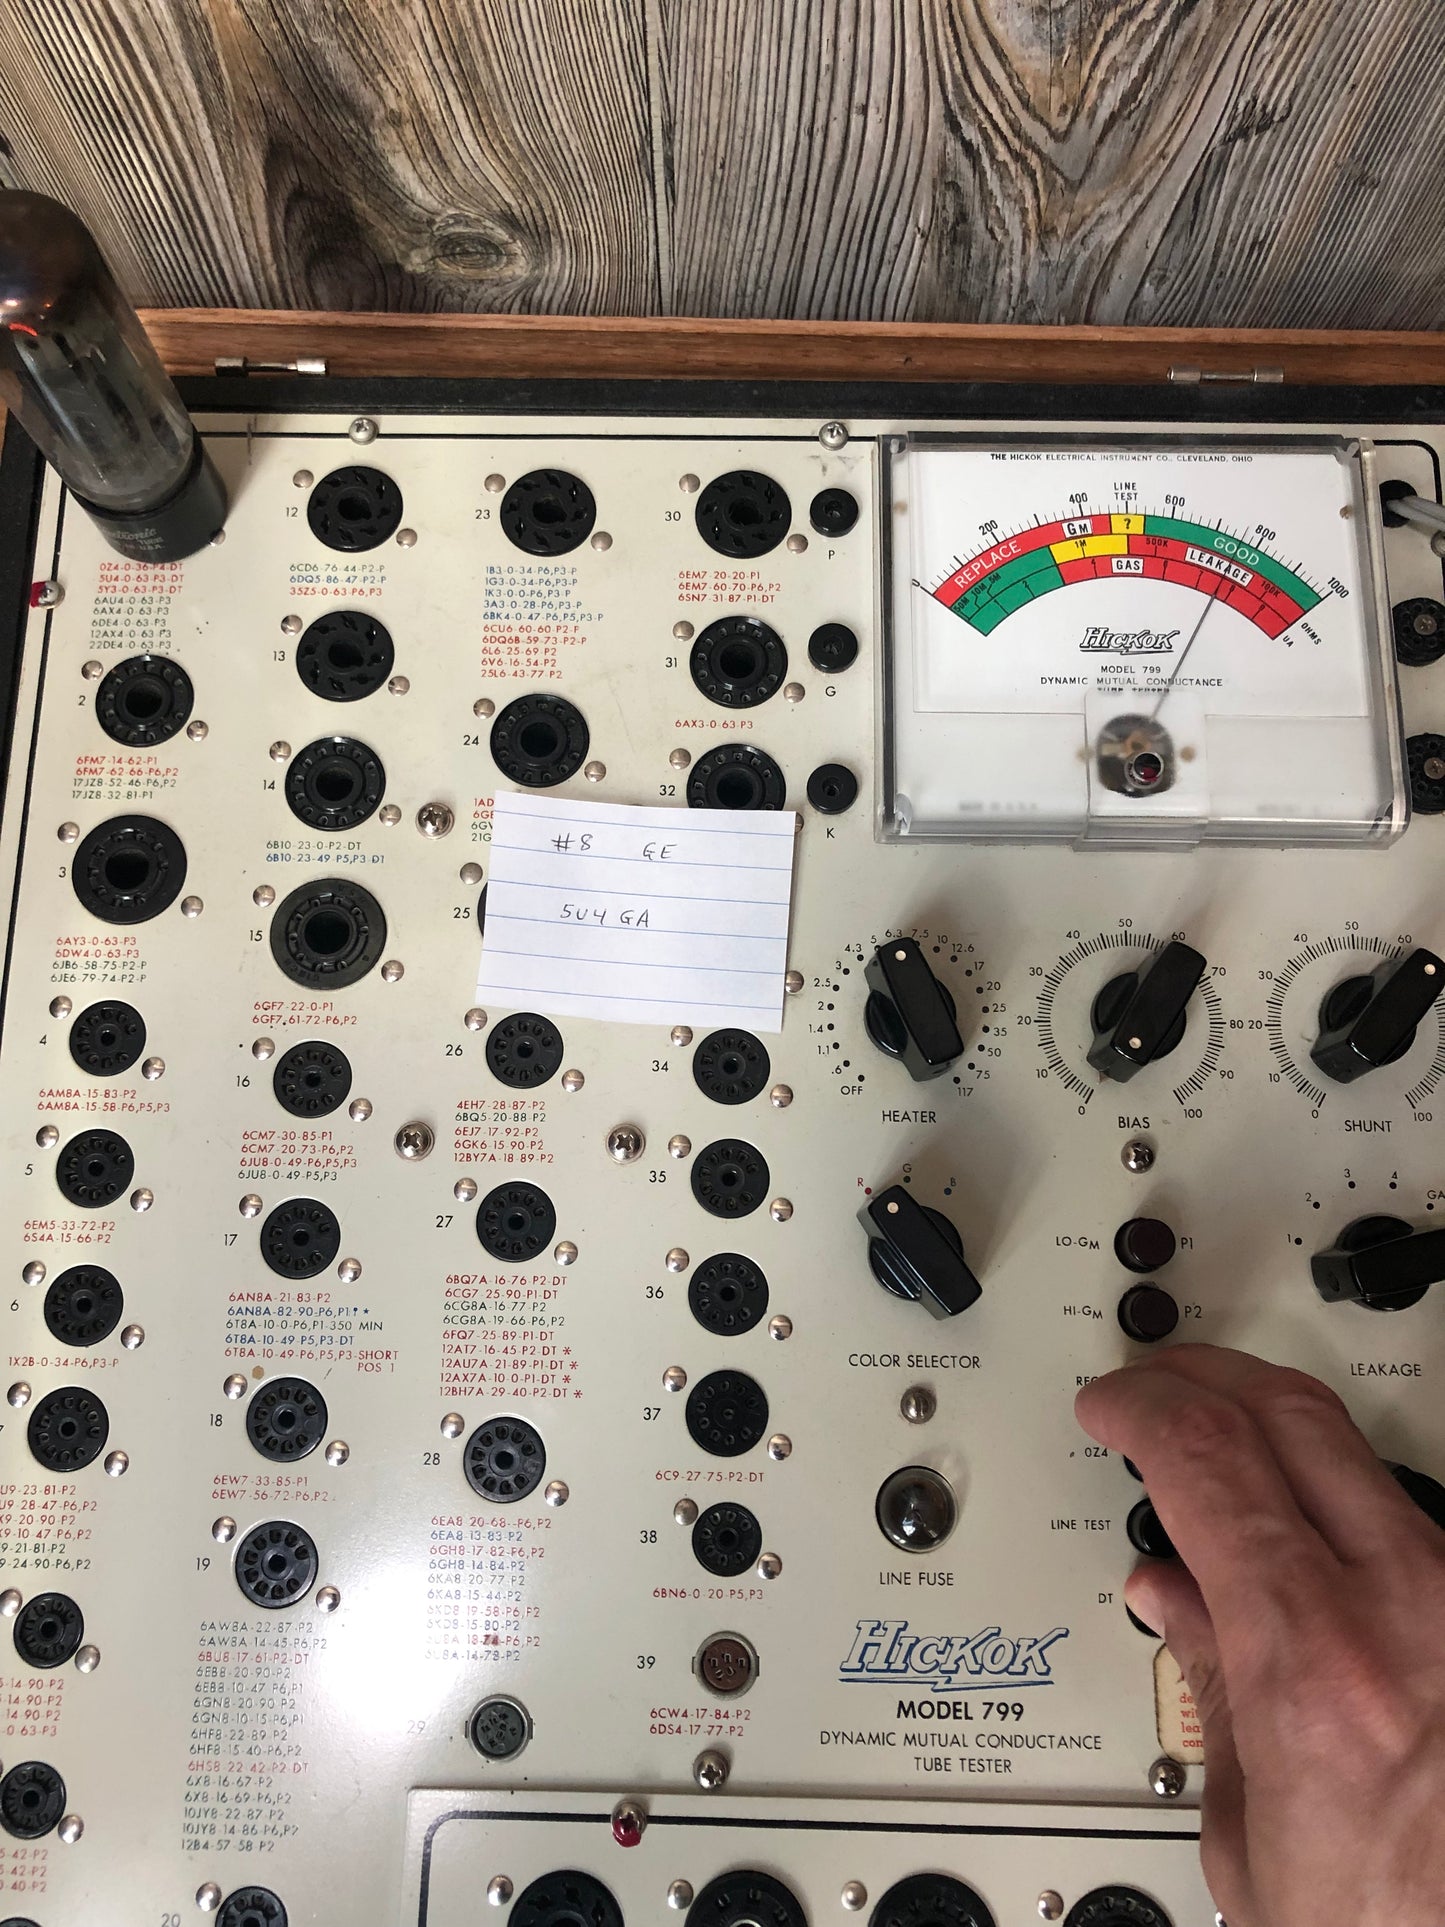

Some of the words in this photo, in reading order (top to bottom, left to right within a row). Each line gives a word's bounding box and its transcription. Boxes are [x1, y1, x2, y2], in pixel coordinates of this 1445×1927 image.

[1069, 493, 1088, 503] 400
[1115, 492, 1138, 500] TEST
[1165, 495, 1185, 506] 600
[285, 508, 298, 517] 12
[475, 510, 490, 519] 23
[665, 512, 681, 522] 30
[979, 520, 998, 535] 200
[1255, 525, 1276, 541] 800
[1214, 537, 1260, 566] GOOD
[954, 541, 1021, 588] REPLACE
[1116, 560, 1141, 570] GAS
[1189, 549, 1250, 583] LEAKAGE
[1327, 577, 1349, 599] 1000
[1301, 622, 1322, 645] OHMS
[273, 651, 285, 662] 13
[665, 658, 678, 668] 31
[1097, 677, 1138, 685] MUTUAL
[1146, 678, 1223, 686] CONDUCTANCE
[78, 696, 85, 706] 2
[463, 736, 479, 746] 24
[263, 780, 275, 791] 14
[659, 786, 675, 796] 32
[552, 834, 592, 851] #8
[642, 842, 677, 860] GE
[58, 867, 66, 878] 3
[453, 908, 470, 918] 25
[560, 904, 606, 925] 5U4
[620, 910, 649, 927] GA
[1118, 918, 1132, 928] 50
[1345, 921, 1359, 931] 50
[249, 930, 262, 942] 15
[937, 935, 948, 944] 10
[1066, 930, 1081, 939] 40
[1171, 931, 1186, 941] 60
[844, 944, 862, 952] 4.3
[952, 943, 974, 952] 12.6
[974, 962, 984, 971] 17
[1029, 966, 1043, 976] 30
[1212, 966, 1226, 976] 70
[814, 978, 831, 987] 2.5
[987, 982, 1001, 991] 20
[992, 1003, 1006, 1012] 25
[1017, 1016, 1031, 1026] 20
[1230, 1020, 1245, 1030] 80
[1248, 1020, 1263, 1030] 20
[994, 1027, 1007, 1036] 35
[39, 1034, 47, 1045] 4
[445, 1045, 463, 1056] 26
[987, 1048, 1001, 1057] 50
[651, 1060, 669, 1071] 34
[1219, 1069, 1234, 1079] 90
[236, 1076, 250, 1088] 16
[841, 1086, 863, 1096] OFF
[957, 1087, 973, 1097] 117
[882, 1111, 936, 1124] HEATER
[1184, 1109, 1203, 1119] 100
[1413, 1112, 1432, 1122] 100
[1118, 1116, 1150, 1129] BIAS
[1344, 1120, 1393, 1133] SHUNT
[24, 1163, 33, 1176] 5
[903, 1163, 911, 1173] G
[648, 1171, 666, 1182] 35
[857, 1178, 864, 1187] R
[950, 1178, 956, 1187] B
[435, 1216, 453, 1227] 27
[224, 1234, 238, 1246] 17
[1181, 1237, 1193, 1250] P1
[646, 1287, 664, 1298] 36
[10, 1299, 19, 1311] 6
[1185, 1305, 1202, 1319] P2
[359, 1321, 383, 1331] MIN
[849, 1354, 900, 1368] COLOR
[907, 1355, 981, 1369] SELECTOR
[357, 1362, 382, 1373] POS
[1350, 1363, 1422, 1377] LEAKAGE
[643, 1408, 661, 1420] 37
[209, 1414, 223, 1427] 18
[423, 1453, 441, 1465] 28
[1051, 1520, 1077, 1530] LINE
[1085, 1520, 1111, 1531] TEST
[640, 1530, 657, 1543] 38
[196, 1557, 210, 1572] 19
[880, 1572, 911, 1586] LINE
[919, 1573, 954, 1587] FUSE
[1098, 1593, 1113, 1603] DT
[636, 1656, 656, 1669] 39
[897, 1701, 973, 1720] MODEL
[982, 1703, 1024, 1721] 799
[820, 1731, 896, 1747] DYNAMIC
[903, 1733, 968, 1748] MUTUAL
[978, 1734, 1102, 1750] CONDUCTANCE
[914, 1757, 950, 1772] TUBE
[959, 1758, 1012, 1774] TESTER
